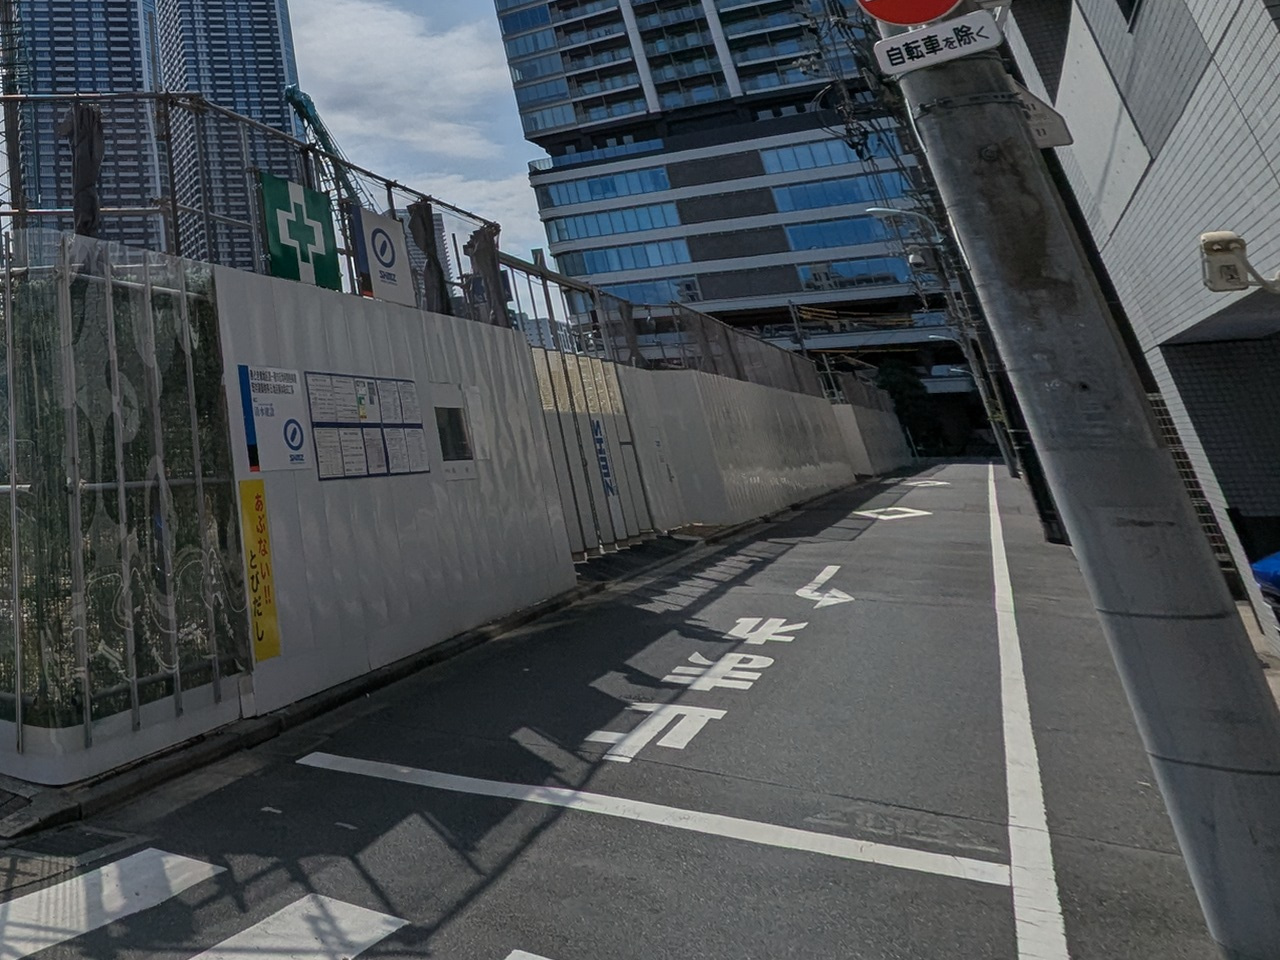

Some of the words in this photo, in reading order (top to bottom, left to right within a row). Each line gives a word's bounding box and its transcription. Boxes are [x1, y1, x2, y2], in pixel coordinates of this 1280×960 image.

[886, 24, 990, 67] 自転車を除く
[249, 551, 265, 642] とびだし
